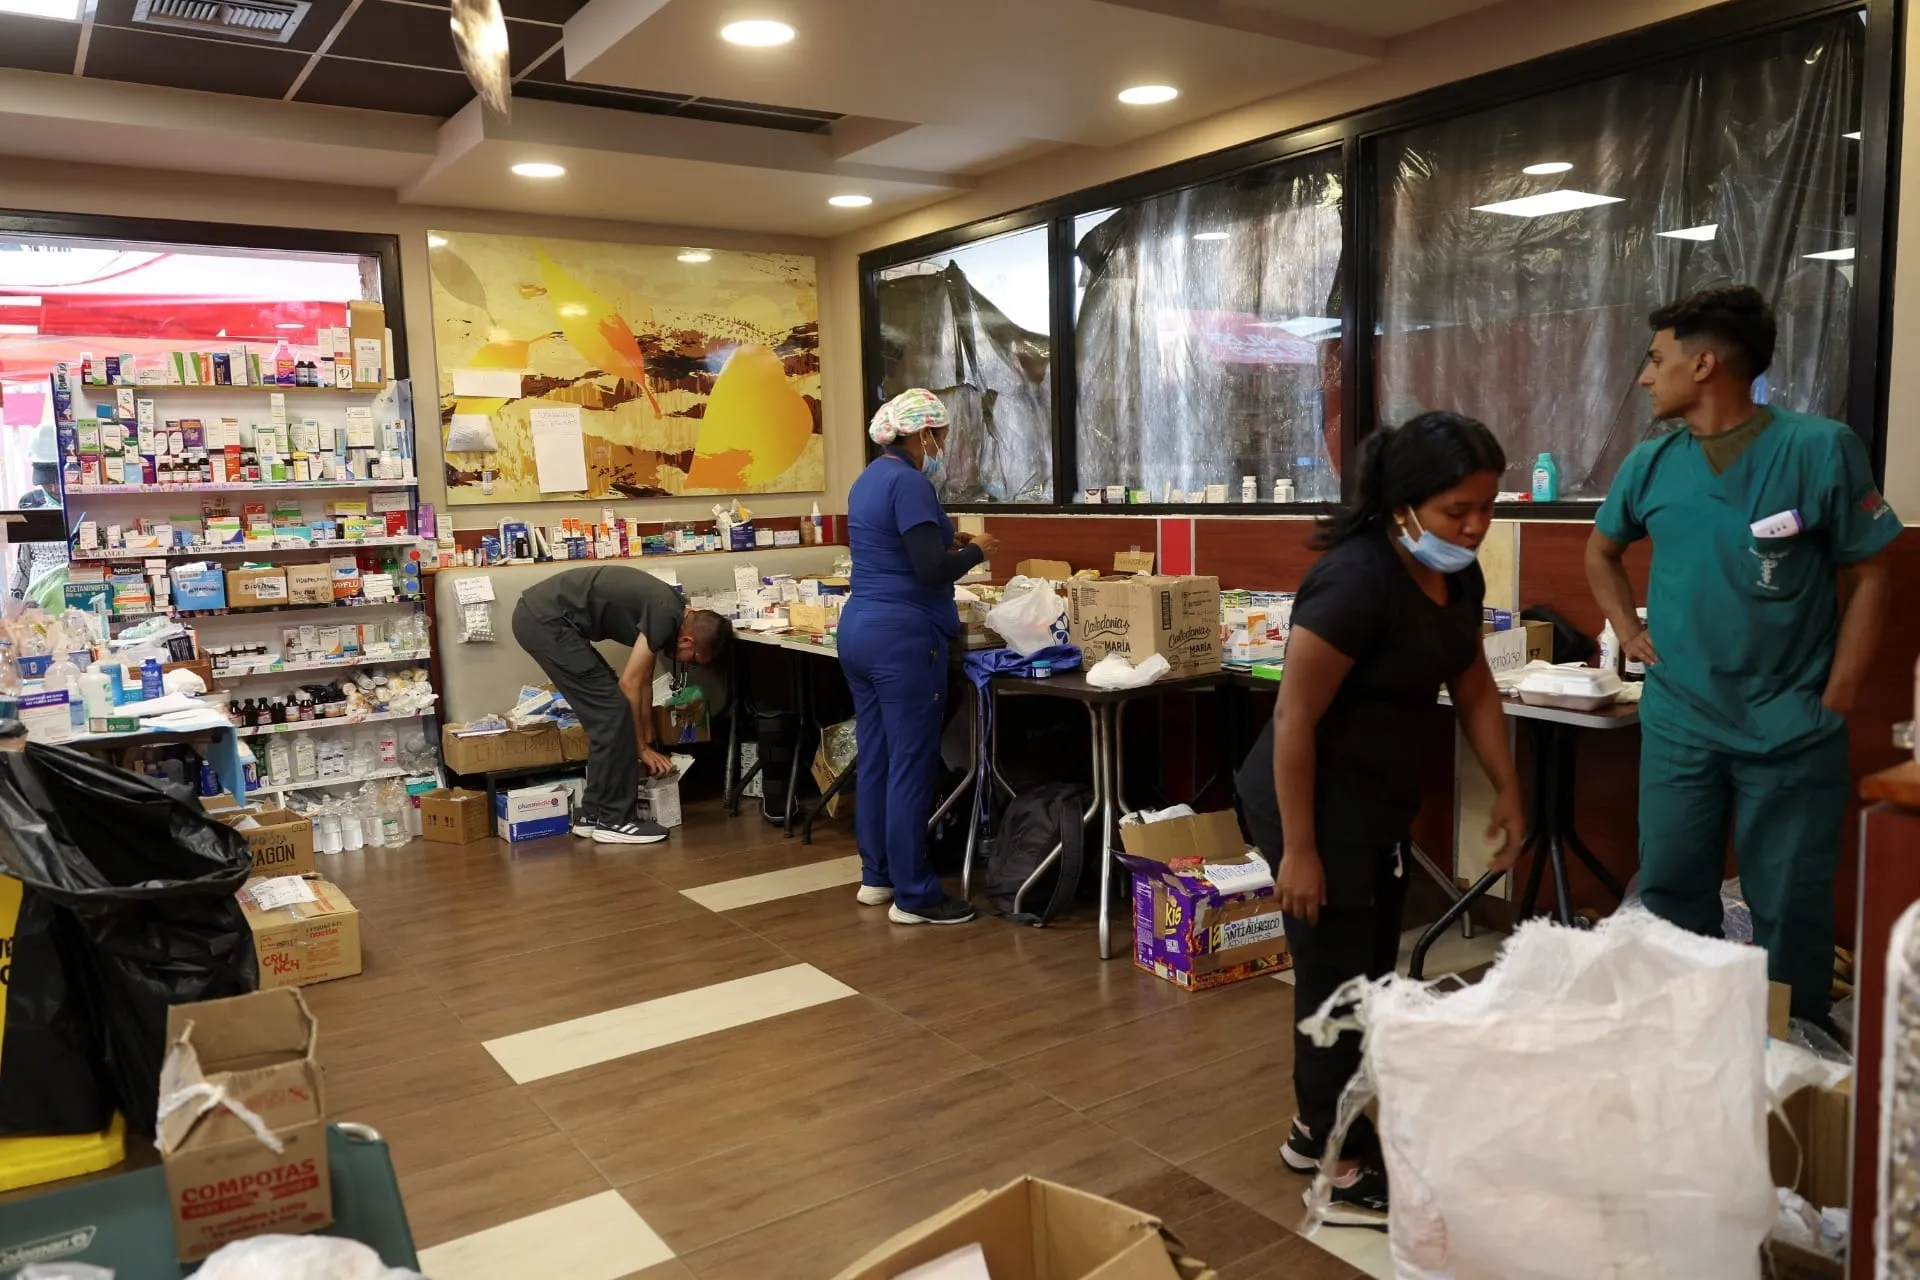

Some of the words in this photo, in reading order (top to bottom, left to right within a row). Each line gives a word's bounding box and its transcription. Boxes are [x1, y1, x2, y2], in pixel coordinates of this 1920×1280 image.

[1104, 640, 1132, 653] MARÍA
[1189, 641, 1213, 654] MARÍA
[1487, 638, 1523, 670] endazol
[250, 841, 296, 868] AGÓN
[181, 1157, 317, 1204] COMPOTAS
